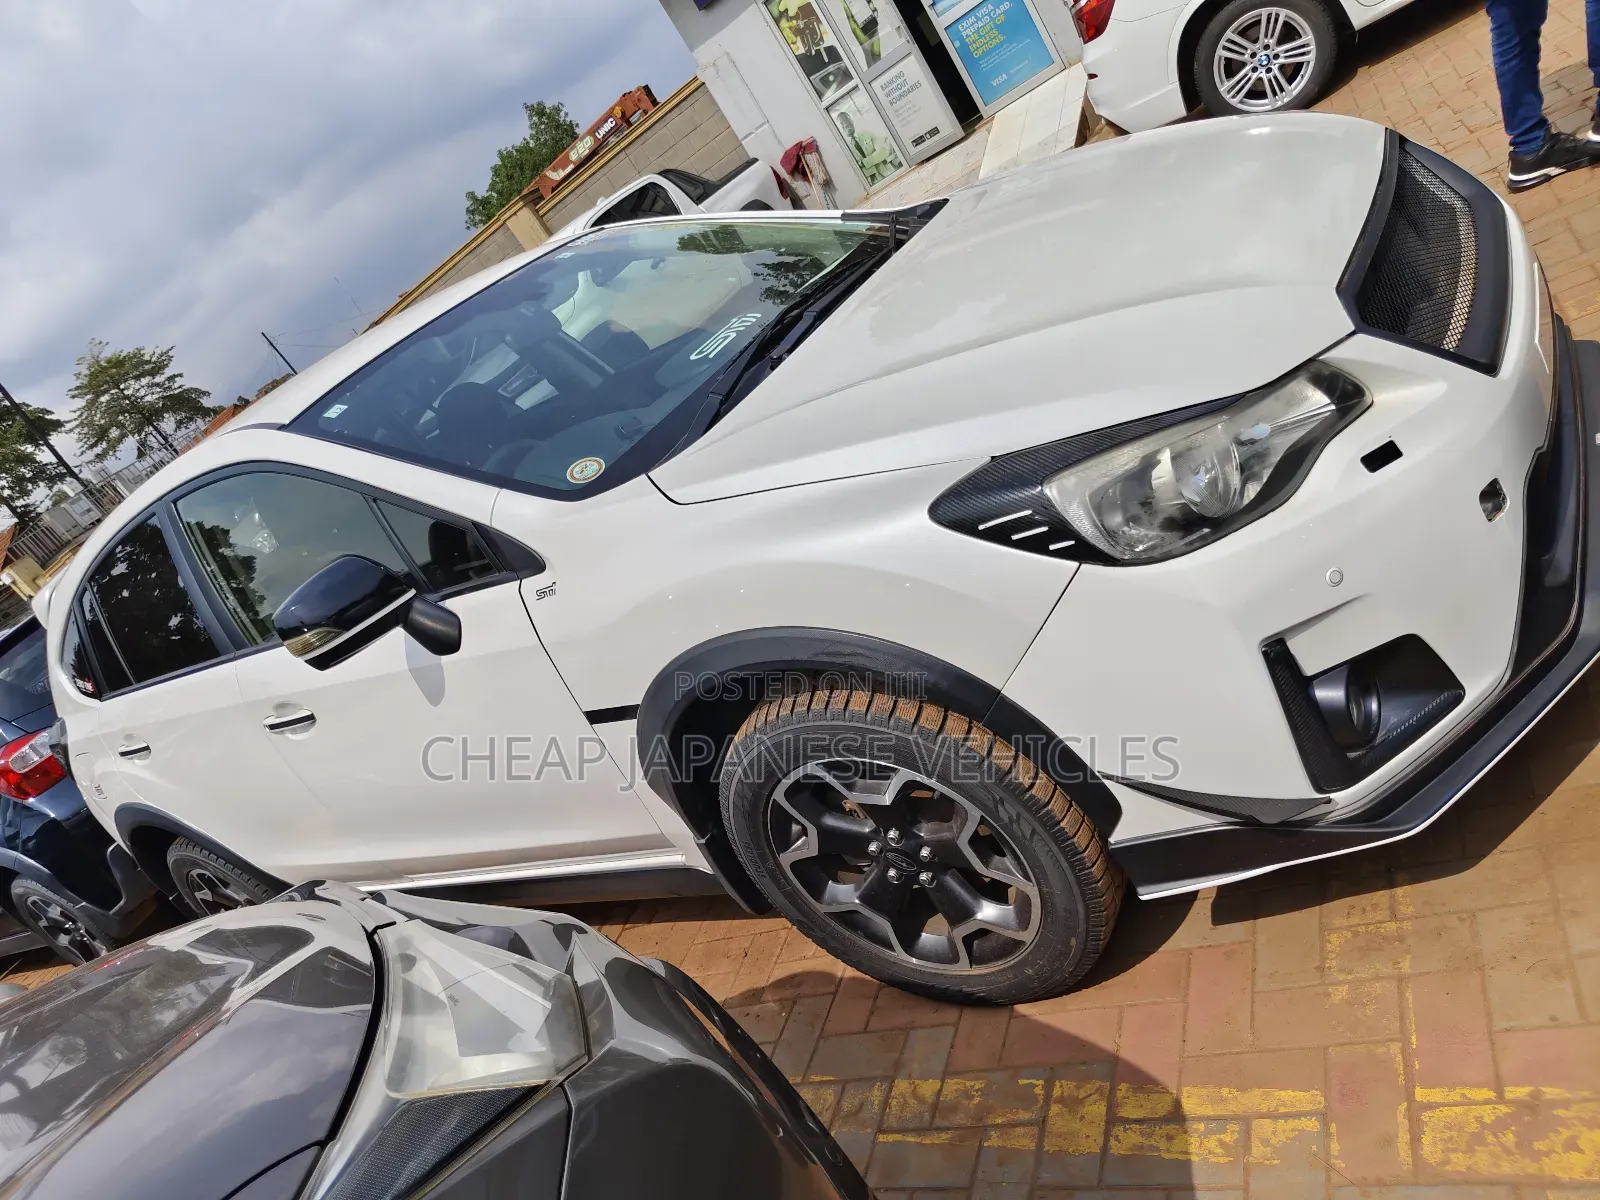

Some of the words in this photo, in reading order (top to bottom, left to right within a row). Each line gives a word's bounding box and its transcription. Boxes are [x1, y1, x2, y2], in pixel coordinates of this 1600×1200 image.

[958, 15, 977, 32] EXIM
[976, 3, 994, 17] VISA
[961, 15, 990, 39] PREPAID
[990, 1, 1013, 18] CARD,
[965, 32, 979, 45] THE
[979, 21, 995, 35] GIFT
[995, 13, 1006, 25] OF
[968, 28, 999, 52] ENDLESS
[972, 34, 1007, 59] OPTIONS.
[880, 70, 905, 92] BANKING
[884, 78, 909, 99] WITHOUT
[990, 73, 1008, 87] VISA
[888, 80, 922, 107] BOUNDARIES
[594, 117, 616, 139] UNIC
